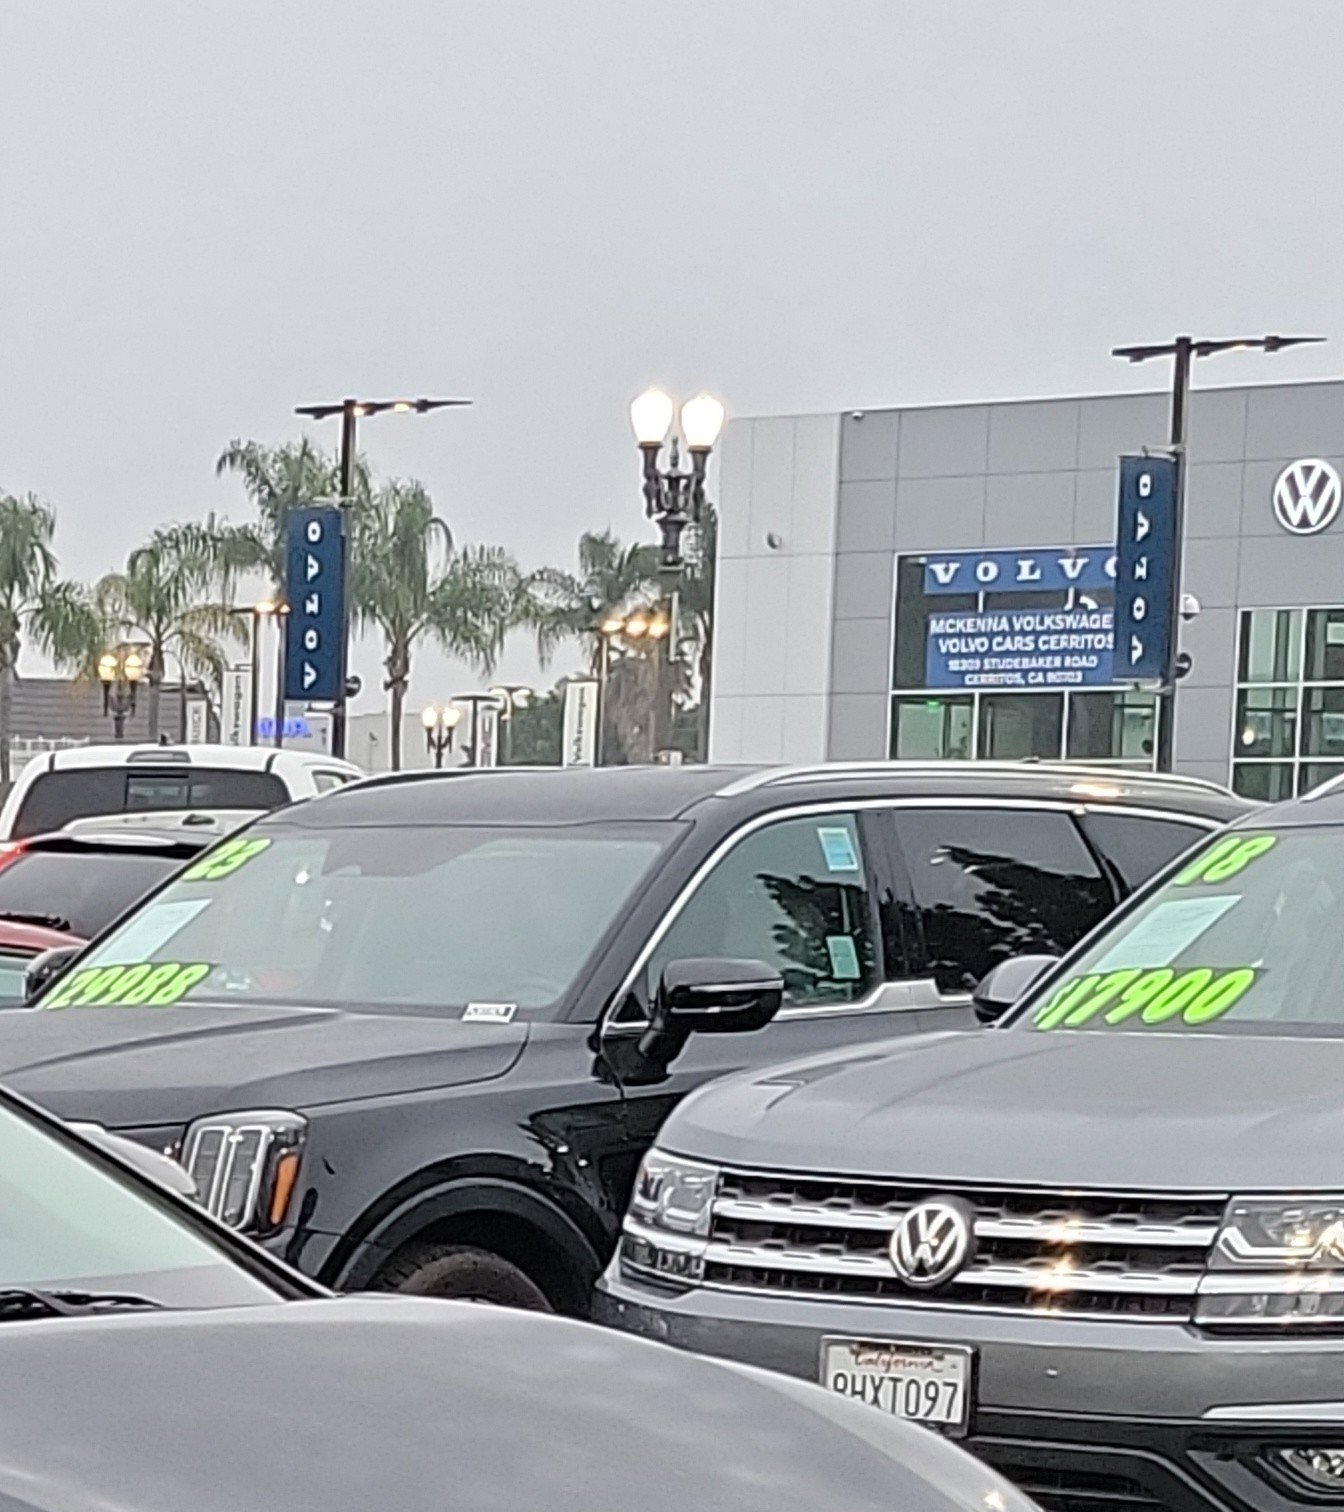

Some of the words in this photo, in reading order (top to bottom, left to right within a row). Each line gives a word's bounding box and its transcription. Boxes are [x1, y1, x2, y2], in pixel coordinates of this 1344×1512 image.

[1130, 472, 1152, 667] VOLVO
[302, 520, 322, 690] VOLVO
[930, 616, 1009, 635] MCKENNA
[1012, 613, 1113, 632] VOLKSWAGE
[938, 636, 989, 654] VOLVO
[992, 634, 1036, 651] CARS
[983, 655, 1061, 671] STUDEBAKER
